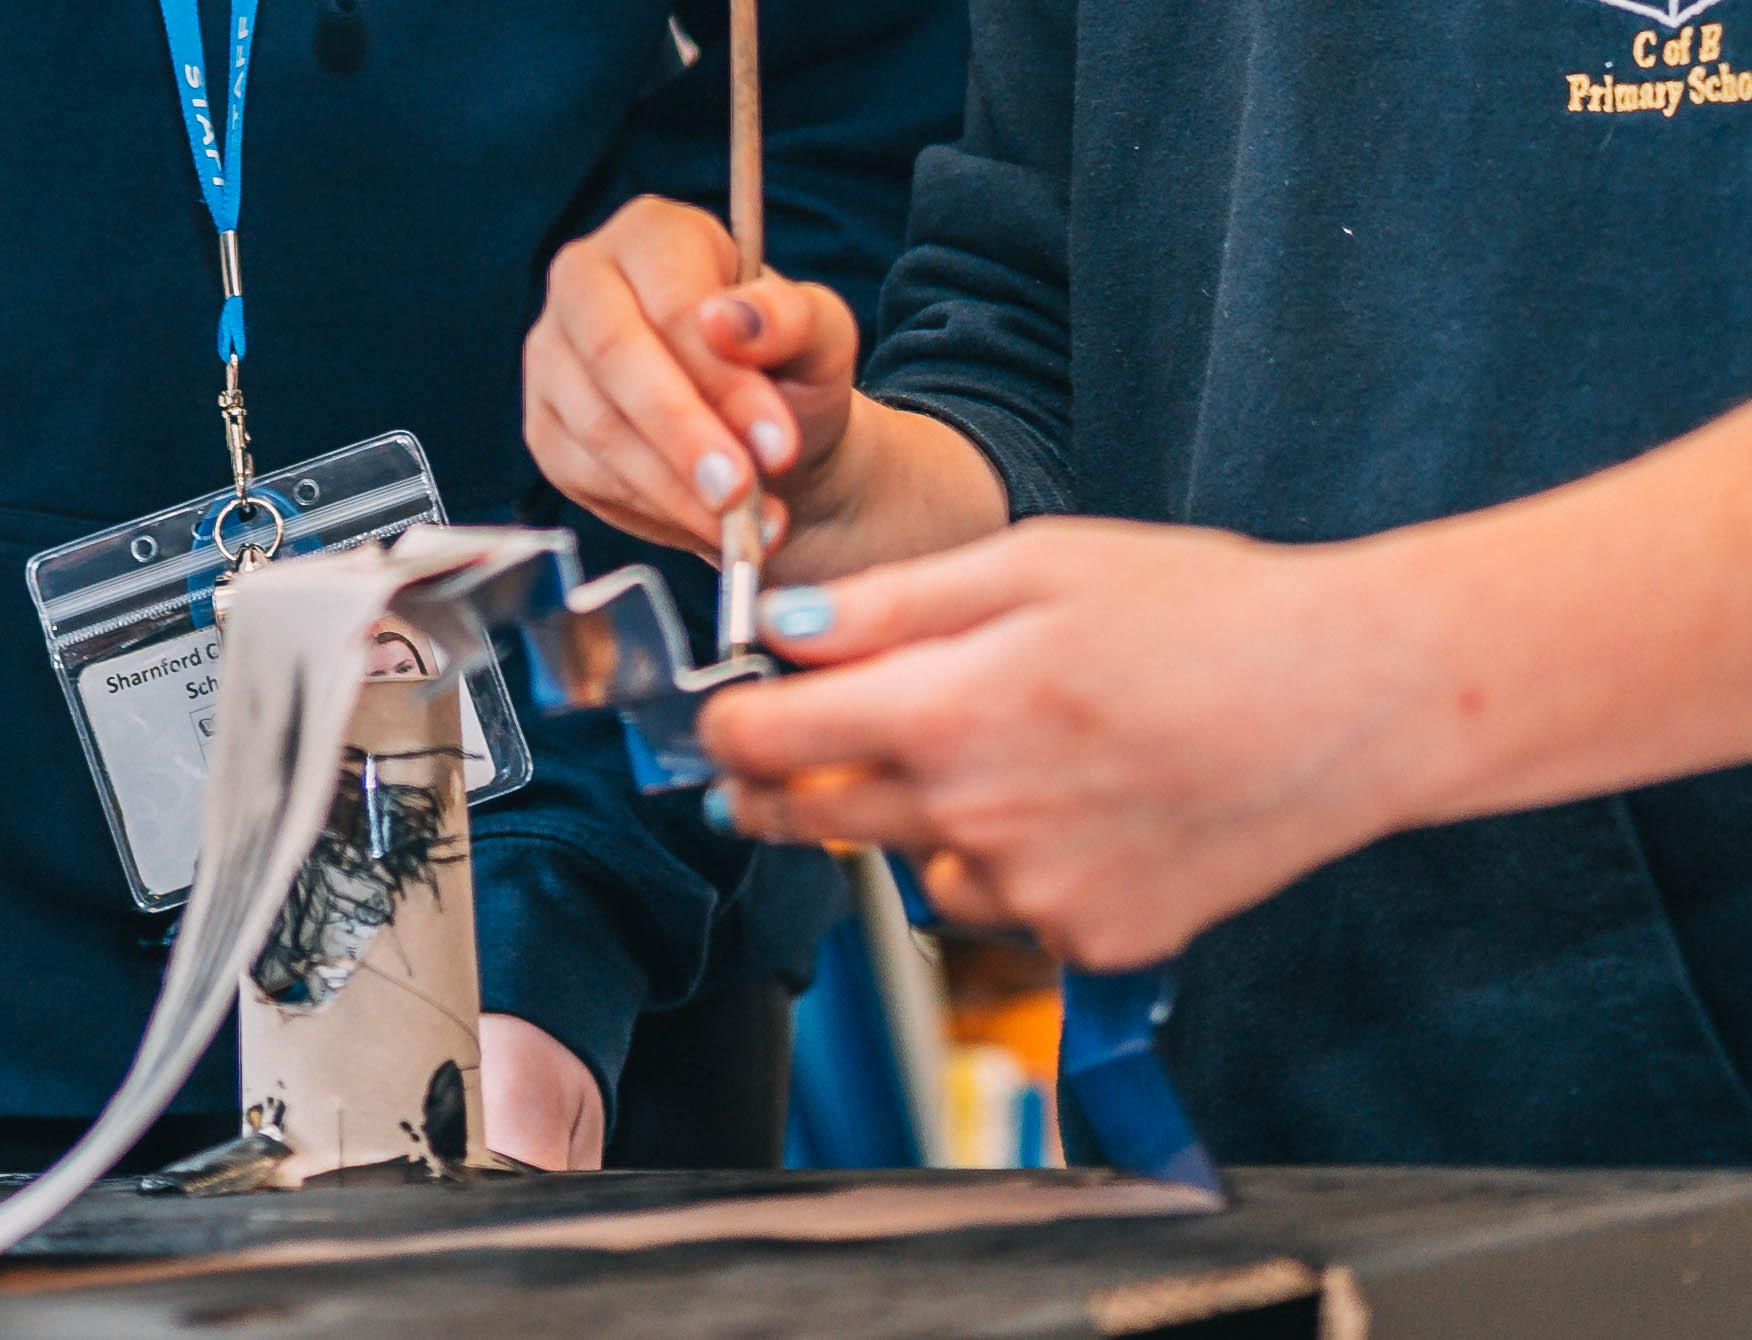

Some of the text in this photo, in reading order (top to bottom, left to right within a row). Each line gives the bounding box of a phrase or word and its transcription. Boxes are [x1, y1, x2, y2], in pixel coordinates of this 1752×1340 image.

[1632, 22, 1723, 69] C of E
[1565, 73, 1683, 118] Primary
[105, 647, 203, 694] Sharnford
[185, 674, 220, 700] Sch
